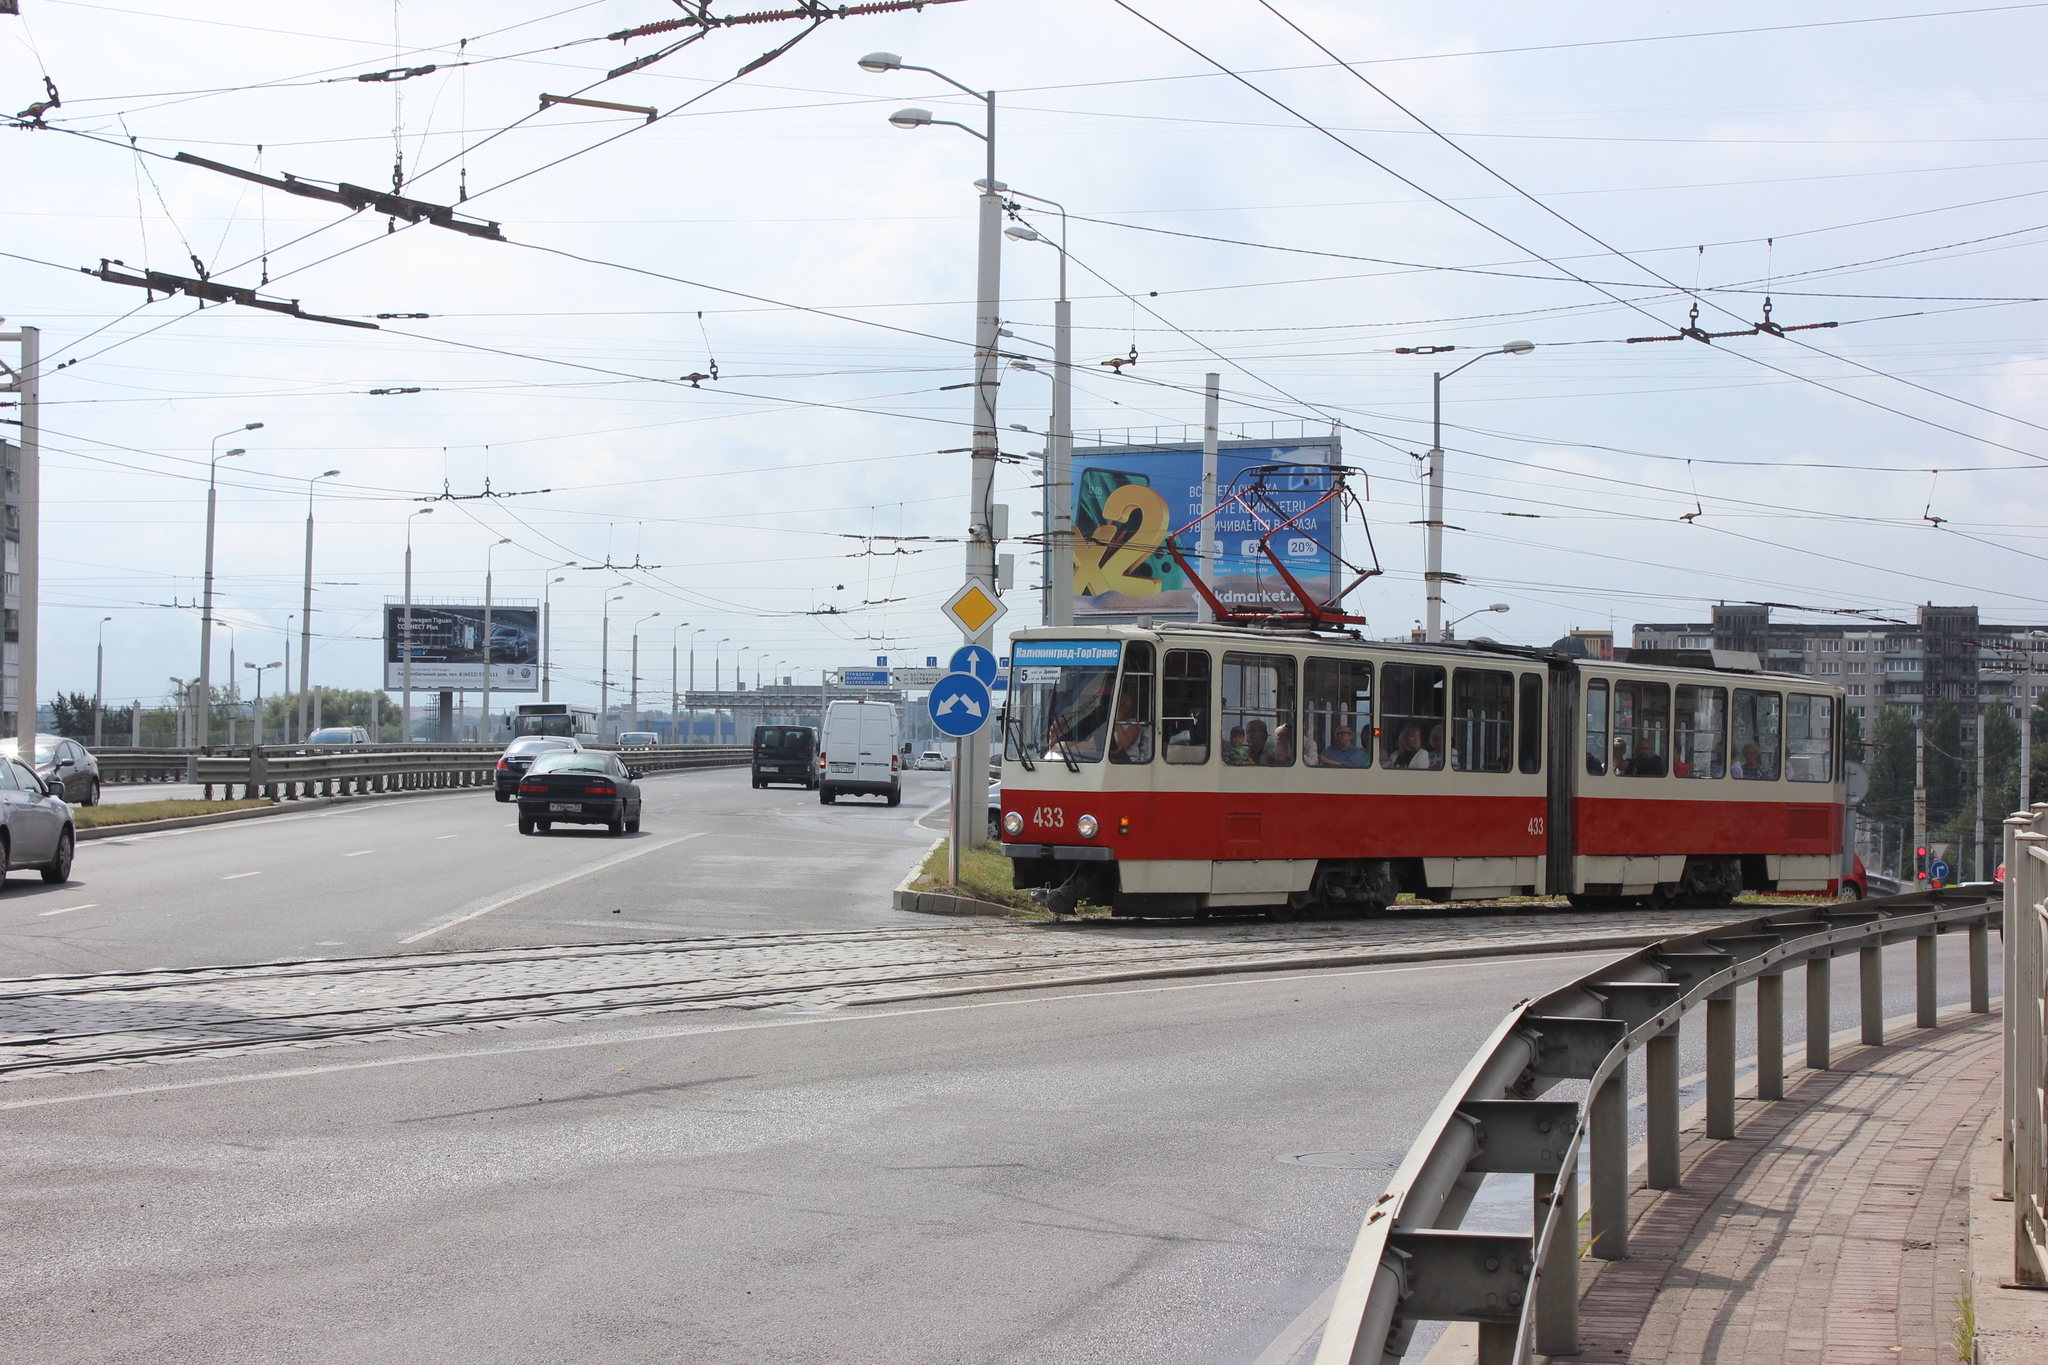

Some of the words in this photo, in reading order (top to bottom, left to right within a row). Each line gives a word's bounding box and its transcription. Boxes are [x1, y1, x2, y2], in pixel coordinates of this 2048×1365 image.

[1189, 519, 1271, 533] УВИЧИВАЕТСЯ
[1291, 541, 1314, 553] 20%
[432, 617, 453, 625] Tiguan
[1016, 647, 1118, 660] Калининград-ГорТранс
[1021, 669, 1028, 682] 5
[1033, 806, 1065, 828] 433
[1527, 817, 1544, 836] 433
